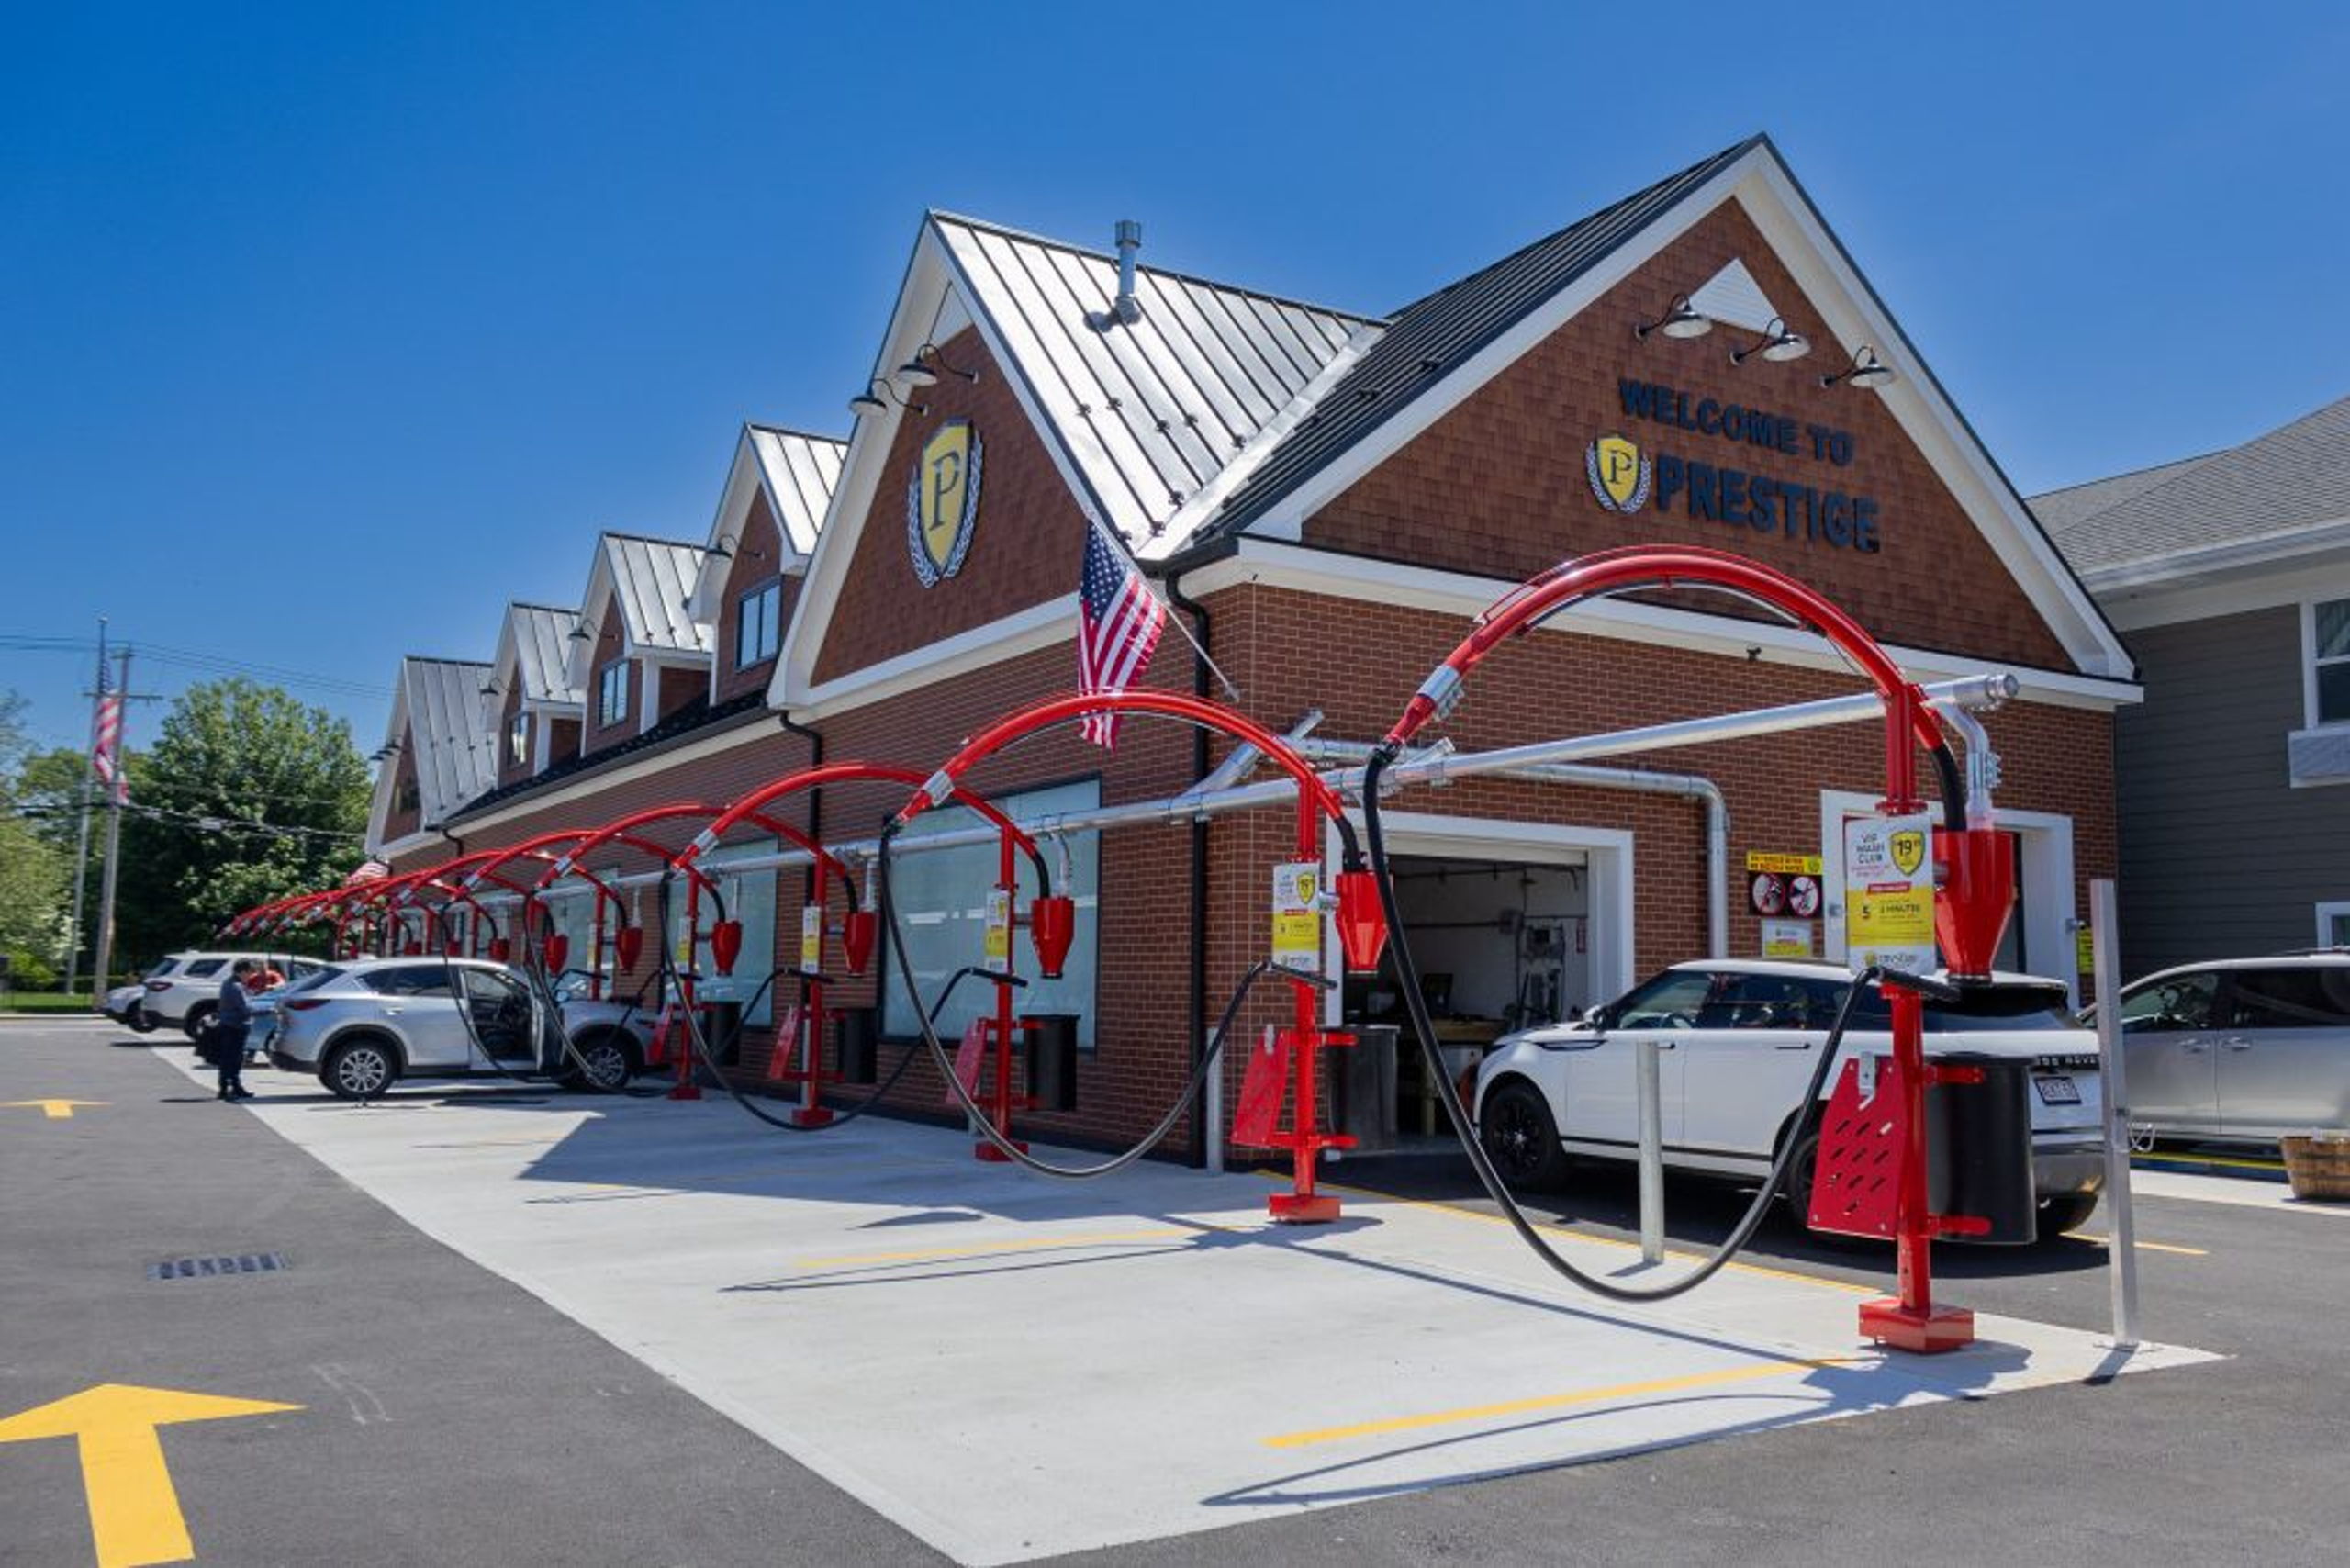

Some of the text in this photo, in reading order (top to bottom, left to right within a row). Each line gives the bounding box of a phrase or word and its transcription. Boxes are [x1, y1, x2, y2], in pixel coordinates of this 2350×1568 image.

[1618, 377, 1853, 466] WELCOME TO
[929, 450, 960, 532] P
[1611, 449, 1633, 485] P
[1656, 453, 1880, 553] PRESTIGE
